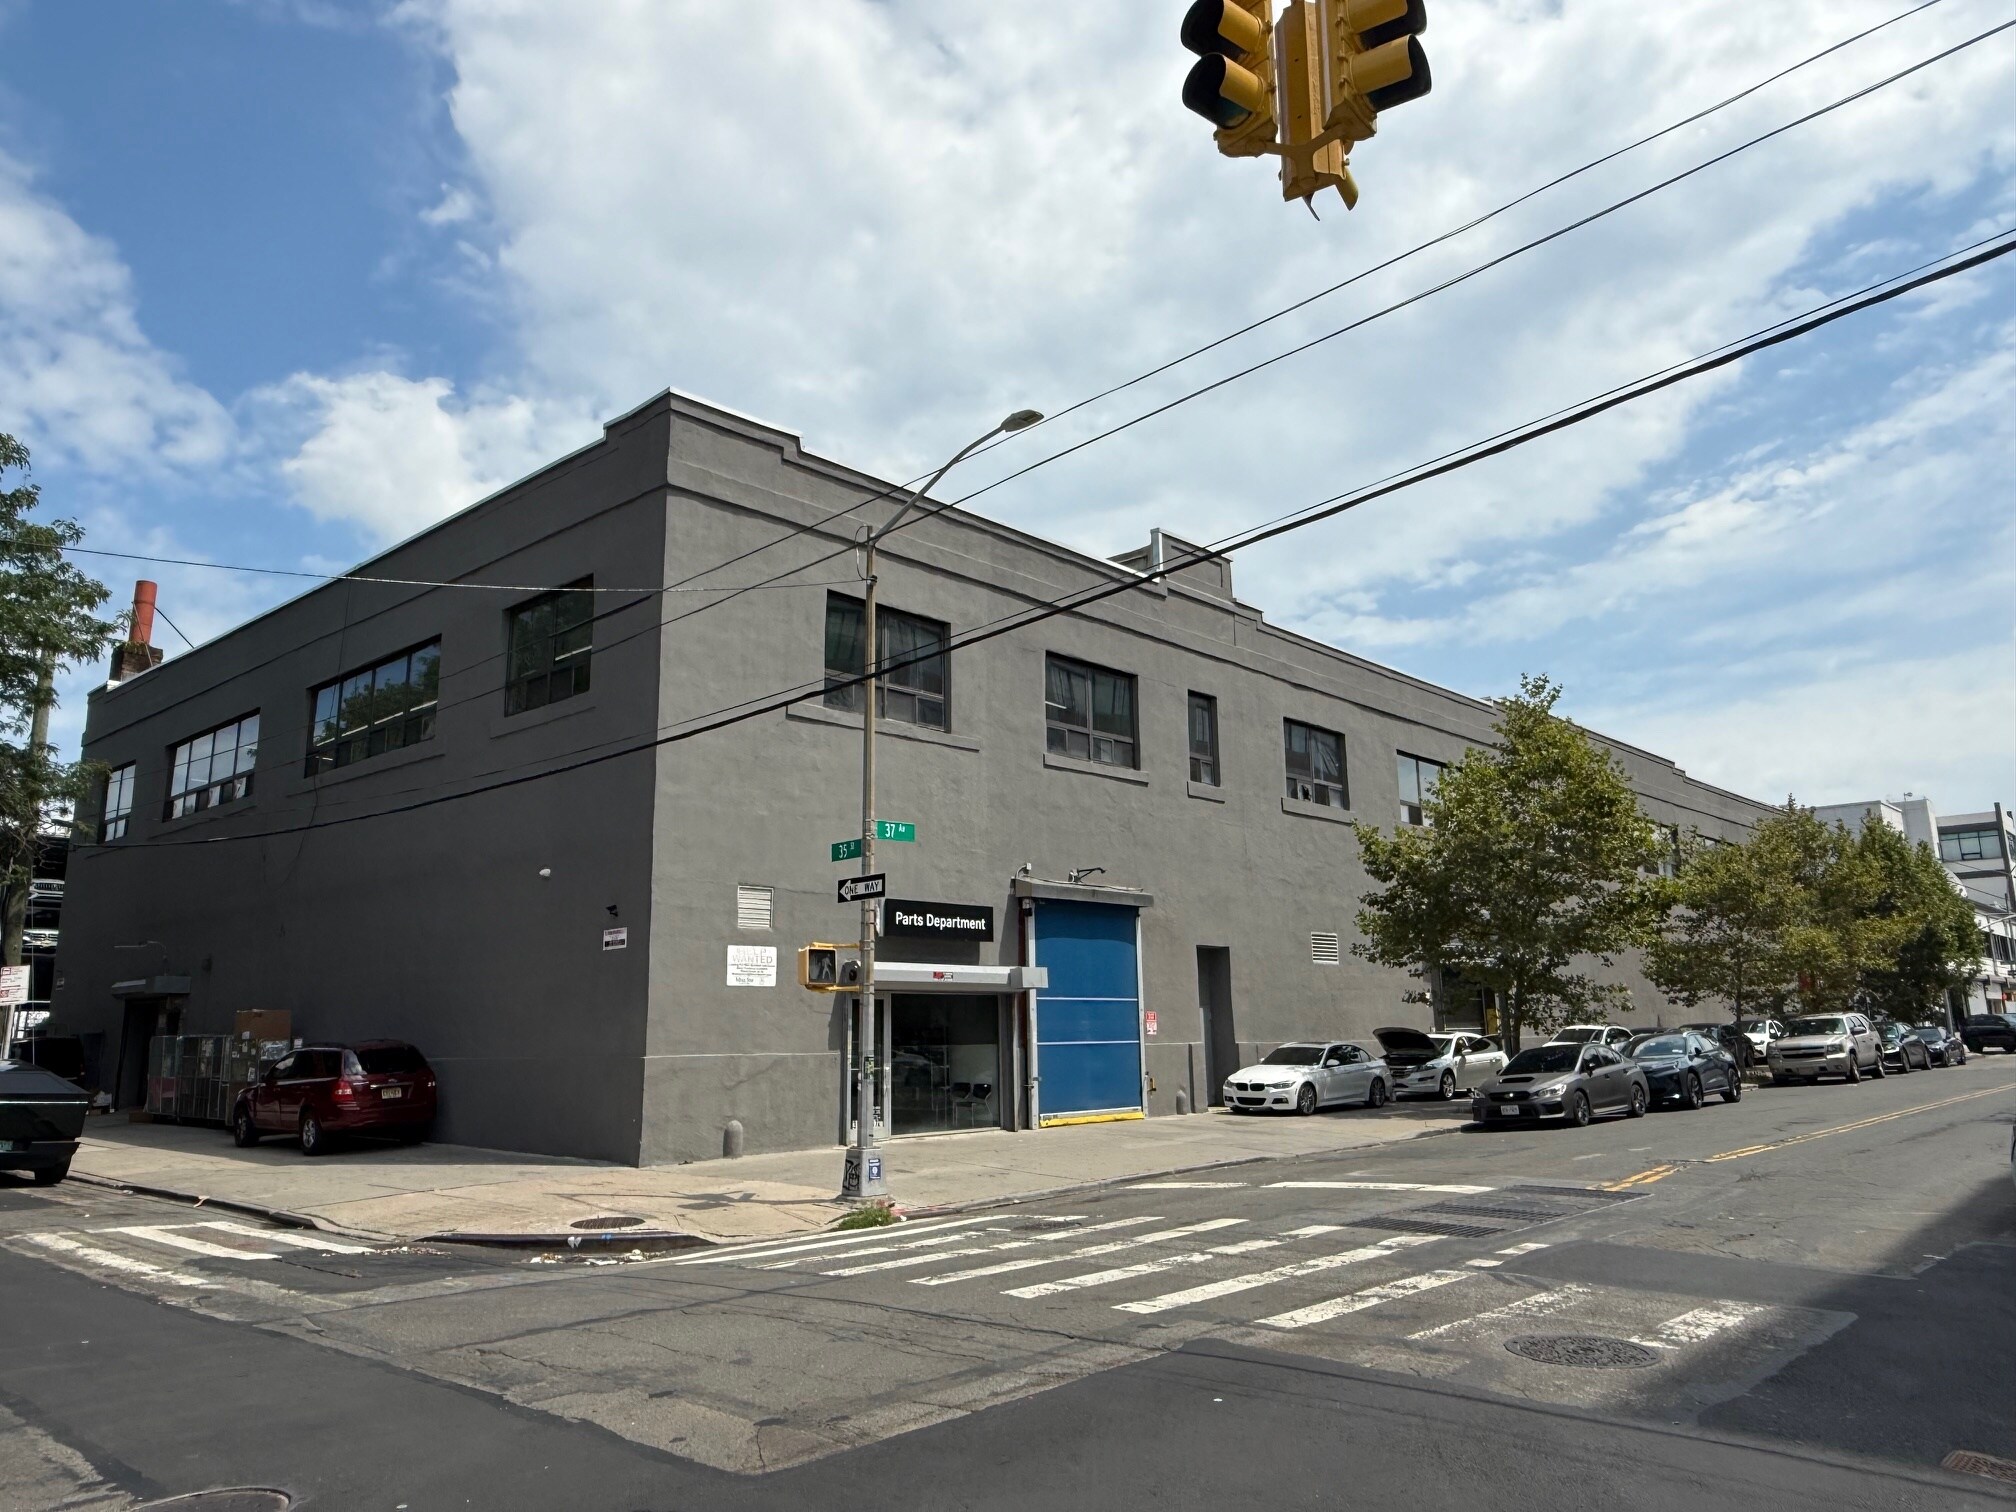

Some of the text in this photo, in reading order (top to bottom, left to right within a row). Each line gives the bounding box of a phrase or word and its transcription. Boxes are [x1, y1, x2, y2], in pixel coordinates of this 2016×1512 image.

[885, 823, 895, 838] 37
[838, 844, 848, 858] 35
[844, 881, 879, 895] ONE WAY
[895, 911, 986, 931] Parts Department
[732, 955, 773, 964] WANTED
